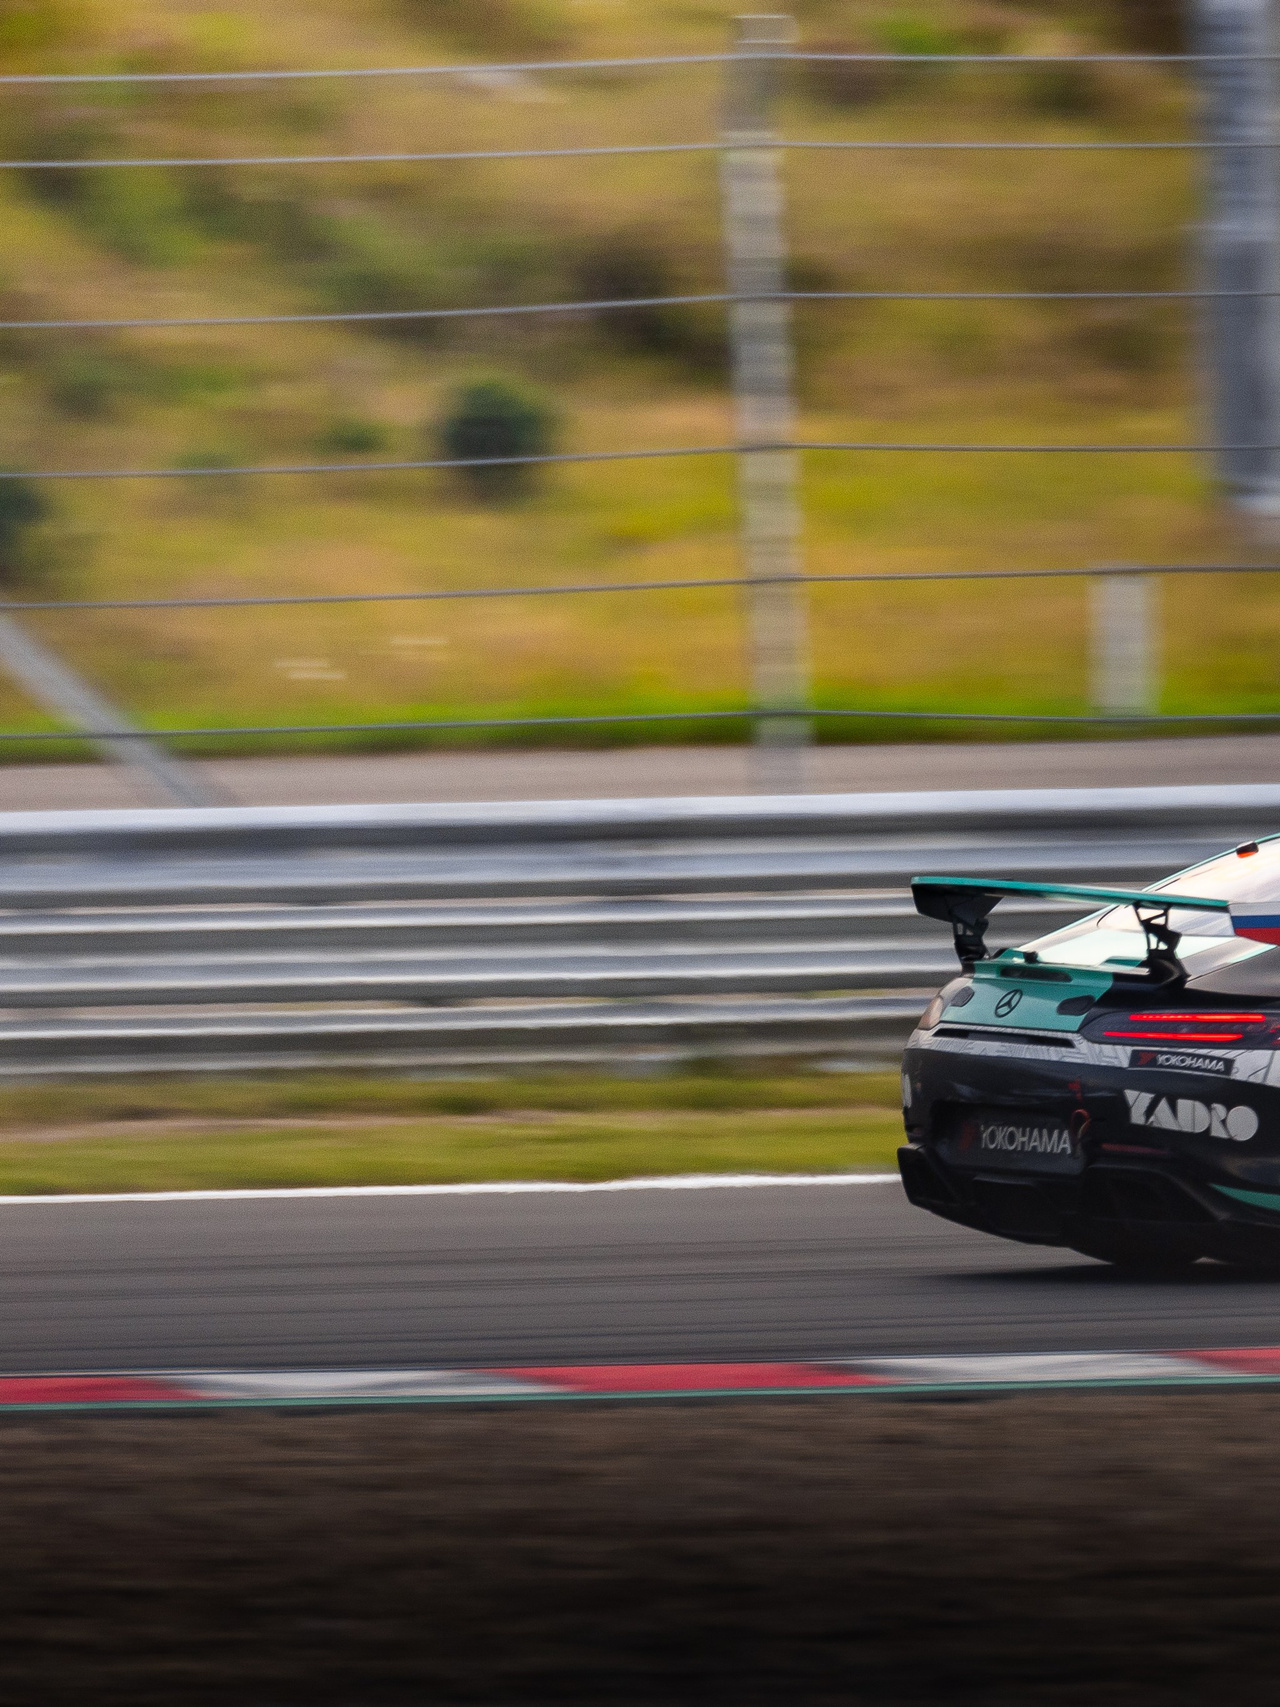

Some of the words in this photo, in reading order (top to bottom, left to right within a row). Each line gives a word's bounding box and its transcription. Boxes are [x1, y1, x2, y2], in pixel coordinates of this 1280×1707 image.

[1156, 1053, 1226, 1073] YOKOHAMA
[1124, 1089, 1259, 1142] YADRO
[980, 1125, 1072, 1154] YOKOHAMA
